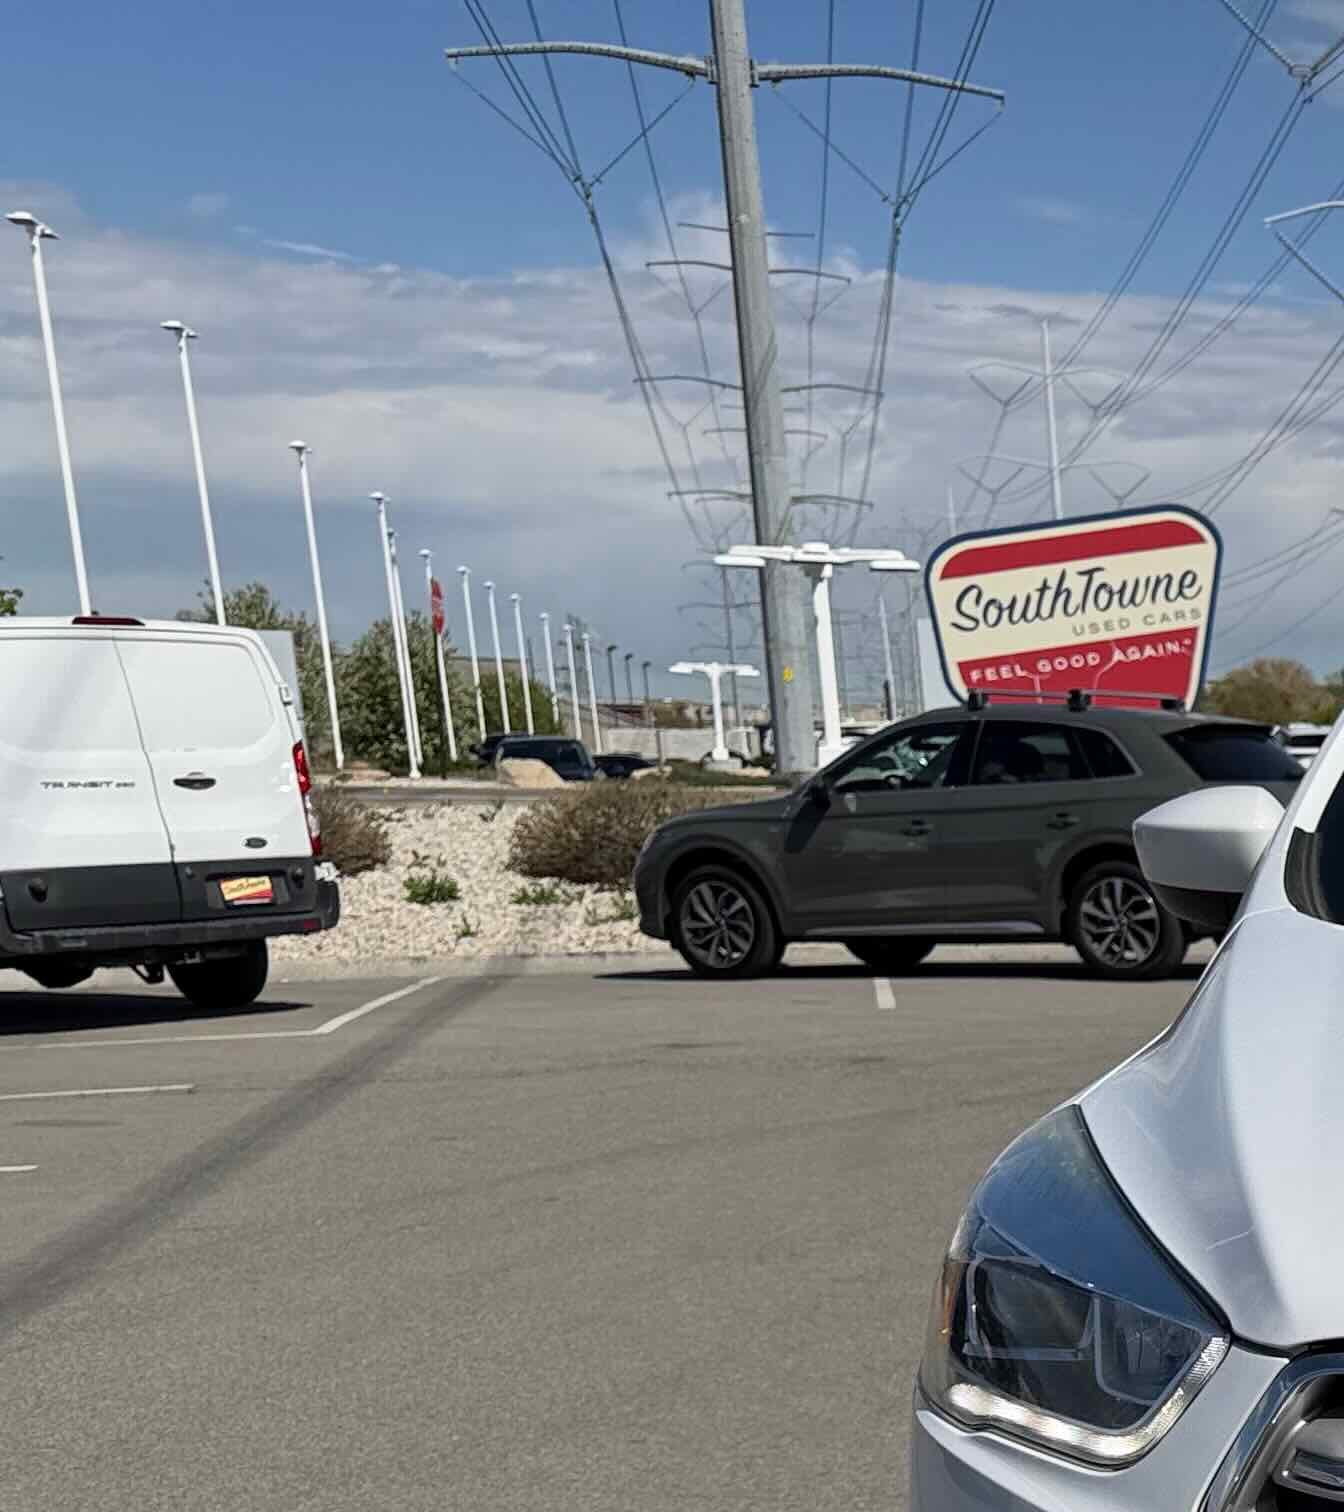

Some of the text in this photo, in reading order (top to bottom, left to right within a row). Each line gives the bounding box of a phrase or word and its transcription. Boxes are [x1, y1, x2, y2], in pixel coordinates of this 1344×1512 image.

[951, 567, 1202, 631] SouthTowne
[1072, 607, 1202, 636] USED CARS
[970, 664, 1026, 683] FEEL
[1036, 651, 1101, 674] GOOD
